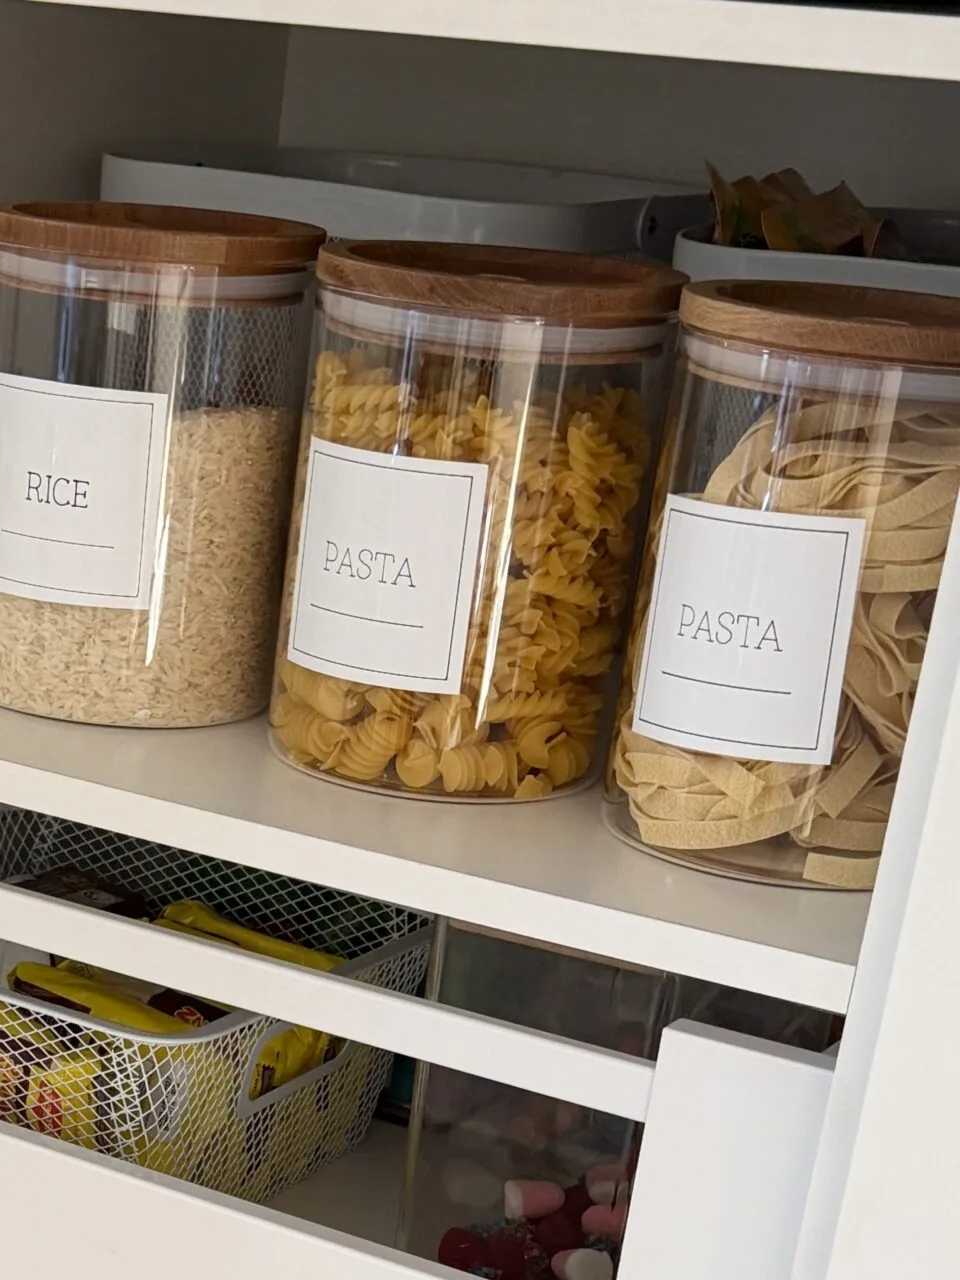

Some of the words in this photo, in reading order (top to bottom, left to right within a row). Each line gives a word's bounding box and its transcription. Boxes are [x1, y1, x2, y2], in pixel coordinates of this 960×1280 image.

[25, 470, 90, 510] RICE
[323, 540, 418, 588] PASTA
[676, 604, 784, 653] PASTA
